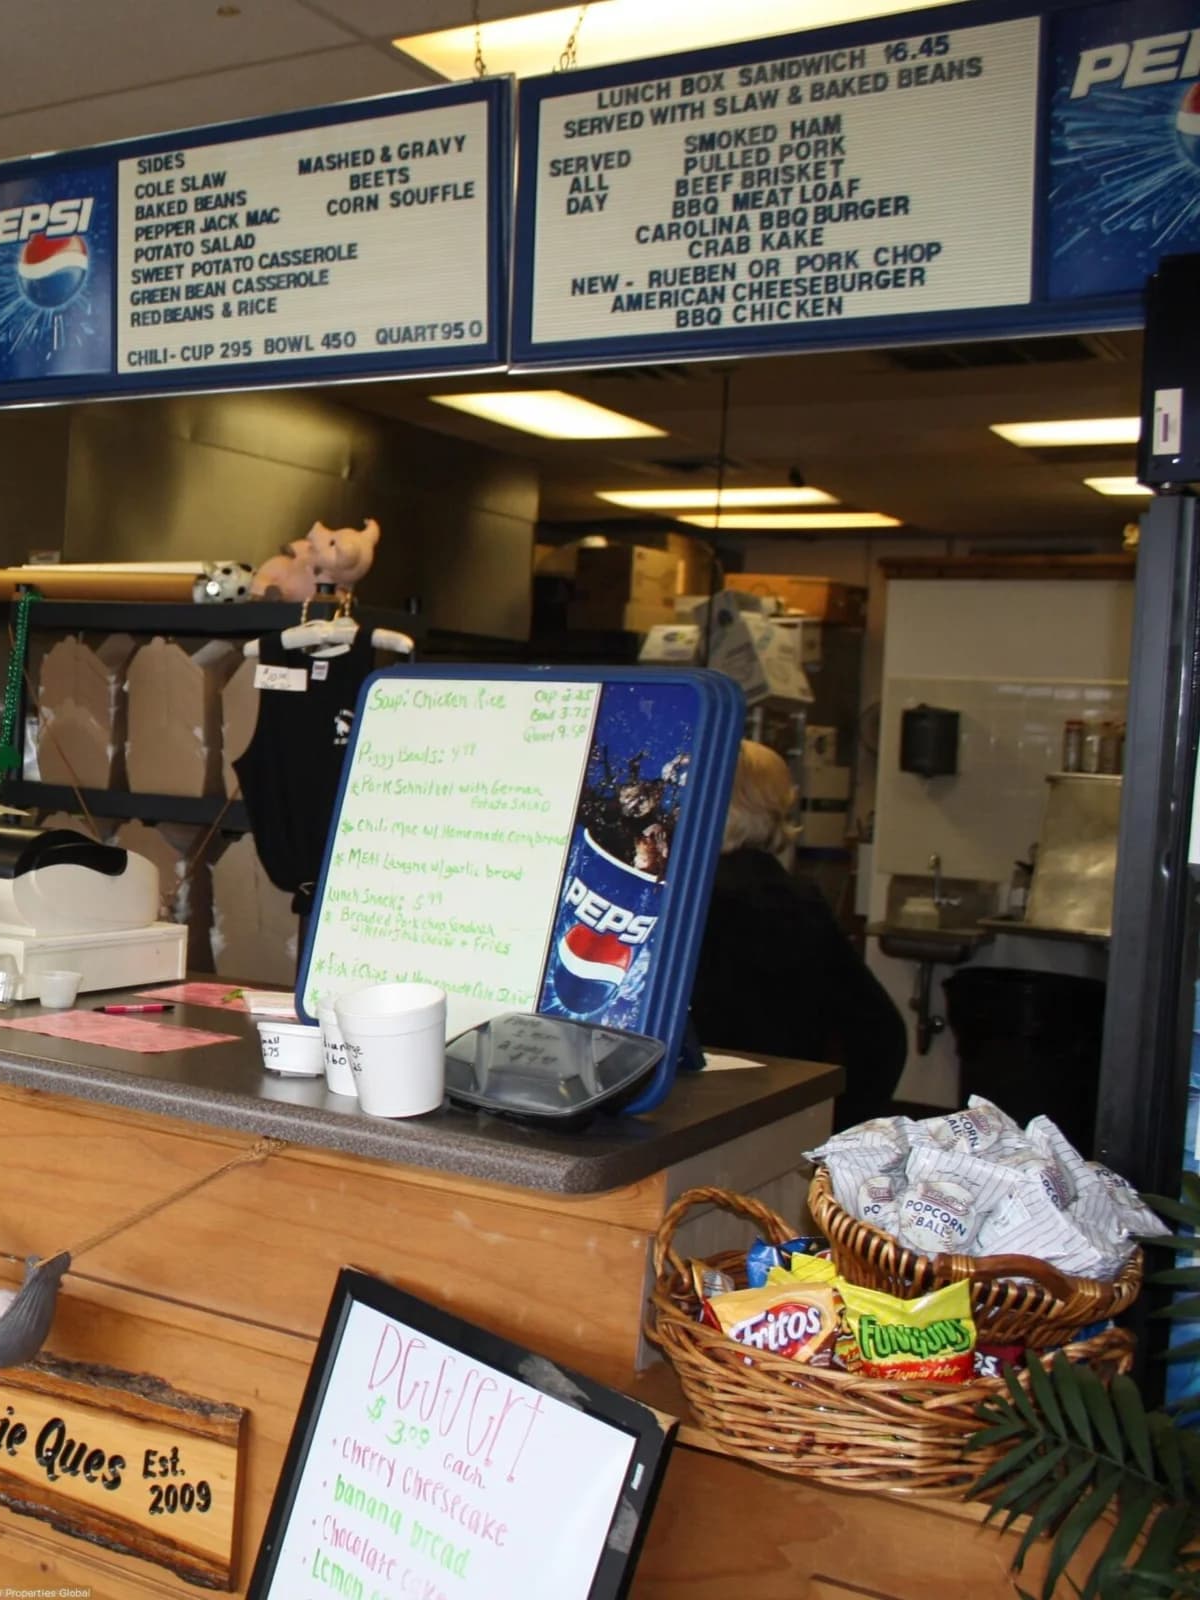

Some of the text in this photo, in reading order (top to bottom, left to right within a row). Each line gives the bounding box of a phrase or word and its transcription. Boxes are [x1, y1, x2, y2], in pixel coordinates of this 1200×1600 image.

[597, 81, 670, 110] LUNCH
[681, 72, 724, 97] BOX
[740, 48, 865, 87] SANDWICH
[1070, 27, 1200, 99] PE
[564, 57, 983, 139] SERVED WITH SLAW & BAKED BEANS
[684, 114, 842, 154] SMOKED HAM
[138, 152, 185, 174] SIDES
[298, 135, 466, 175] MASHED & GRAVY
[550, 150, 631, 177] SERVED
[684, 136, 846, 176] PULLED PORK
[135, 171, 227, 199] COLE SLAW
[349, 167, 409, 190] BEETS
[569, 174, 609, 195] ALL
[676, 159, 845, 197] BEEF BRISKET
[135, 191, 247, 221] BAKED BEANS
[327, 182, 474, 216] CORN SOUFFLE
[567, 194, 608, 215] DAY
[672, 178, 861, 219] BBQ MEAT LOAF
[134, 208, 280, 242] PEPPER JACK MAC
[636, 195, 910, 244] CAROLINA BBQ BURGER
[134, 234, 255, 263] POTATO SALAD
[689, 227, 824, 259] CRAB KAKE
[132, 243, 358, 285] SWEET POTATO CASSEROLE
[571, 242, 942, 296] NEW RUEBEN OR PORK CHOP
[131, 269, 330, 306] GREEN BEAN CASSEROLE
[610, 266, 926, 313] AMERICAN CHEESEBURGER
[222, 302, 231, 319] &
[238, 298, 278, 316] RICE
[676, 296, 843, 328] BBQ CHICKEN
[181, 342, 214, 362] CUP
[220, 340, 252, 359] 295
[264, 334, 314, 355] BOWL
[321, 331, 356, 349] 450
[376, 324, 439, 345] QUART
[905, 1200, 966, 1236] POPCORN
[916, 1217, 946, 1237] BALL
[731, 1304, 821, 1354] Fritos
[35, 1417, 126, 1490] Ques
[142, 1446, 185, 1479] Est.
[149, 1481, 212, 1515] 2009
[333, 1474, 473, 1580] banana bread
